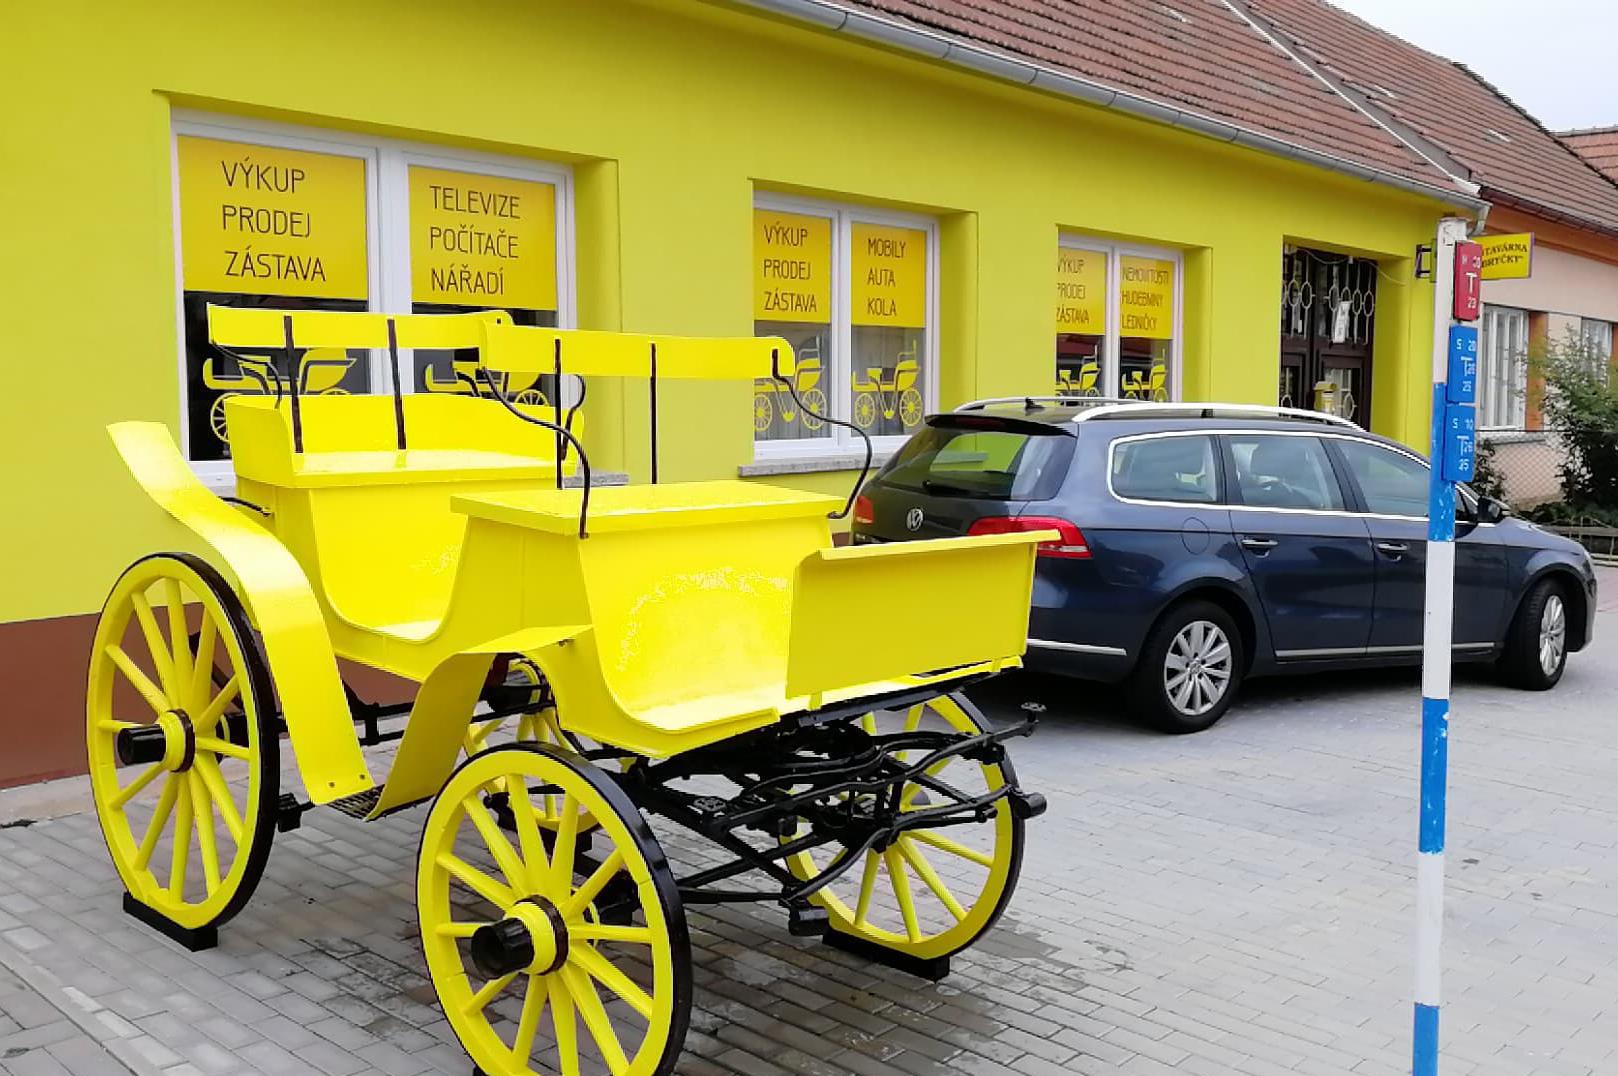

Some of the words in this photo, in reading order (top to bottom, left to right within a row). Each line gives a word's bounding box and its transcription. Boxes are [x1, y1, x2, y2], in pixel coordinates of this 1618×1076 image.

[221, 155, 306, 194] VÝKUP
[430, 185, 521, 220] TELEVIZE
[222, 204, 311, 238] PRODEJ
[763, 221, 808, 247] VÝKUP
[430, 223, 519, 259] POČÍTAČE
[867, 238, 907, 259] MOBILY
[225, 245, 327, 282] ZÁSTAVA
[762, 258, 812, 281] PRODEJ
[867, 268, 896, 287] AUTA
[431, 264, 505, 296] NÁŘADÍ
[763, 287, 818, 313] ZÁSTAVA
[867, 298, 897, 317] KOLA
